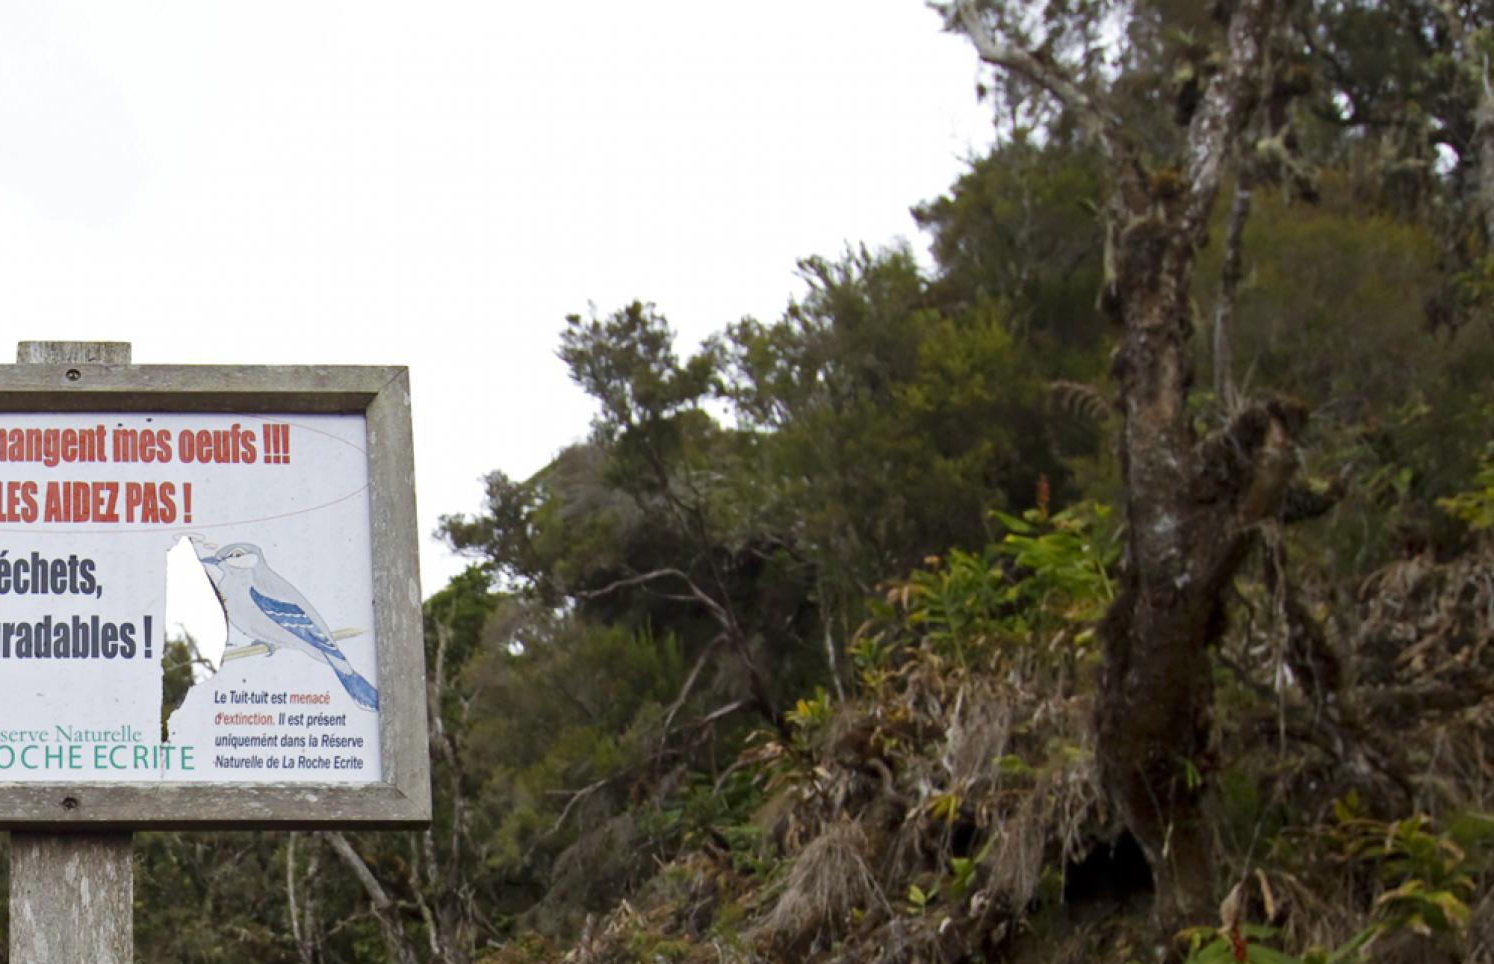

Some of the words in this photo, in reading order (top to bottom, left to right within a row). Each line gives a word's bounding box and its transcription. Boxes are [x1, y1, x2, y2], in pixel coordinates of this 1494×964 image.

[113, 426, 172, 463] mes
[178, 424, 257, 464] oeufs
[263, 424, 291, 464] !!!
[44, 481, 120, 523] AIDEZ
[125, 482, 176, 523] PAS
[183, 482, 192, 523] !
[143, 615, 153, 659] !
[214, 690, 227, 705] Le
[230, 690, 269, 705] Tuit-tuit
[271, 691, 287, 705] est
[289, 690, 331, 705] menacé
[214, 712, 275, 726] d'extinction.
[278, 712, 286, 725] Il
[287, 713, 304, 726] est
[306, 711, 346, 729] présent
[55, 724, 143, 743] Naturelle
[280, 734, 306, 747] dans
[308, 734, 318, 748] la
[321, 733, 364, 748] Réserve
[94, 745, 195, 770] ECRITE
[215, 755, 263, 769] Naturelle
[266, 755, 280, 769] de
[282, 755, 295, 769] La
[298, 755, 331, 769] Roche
[333, 755, 364, 769] Ecrite
